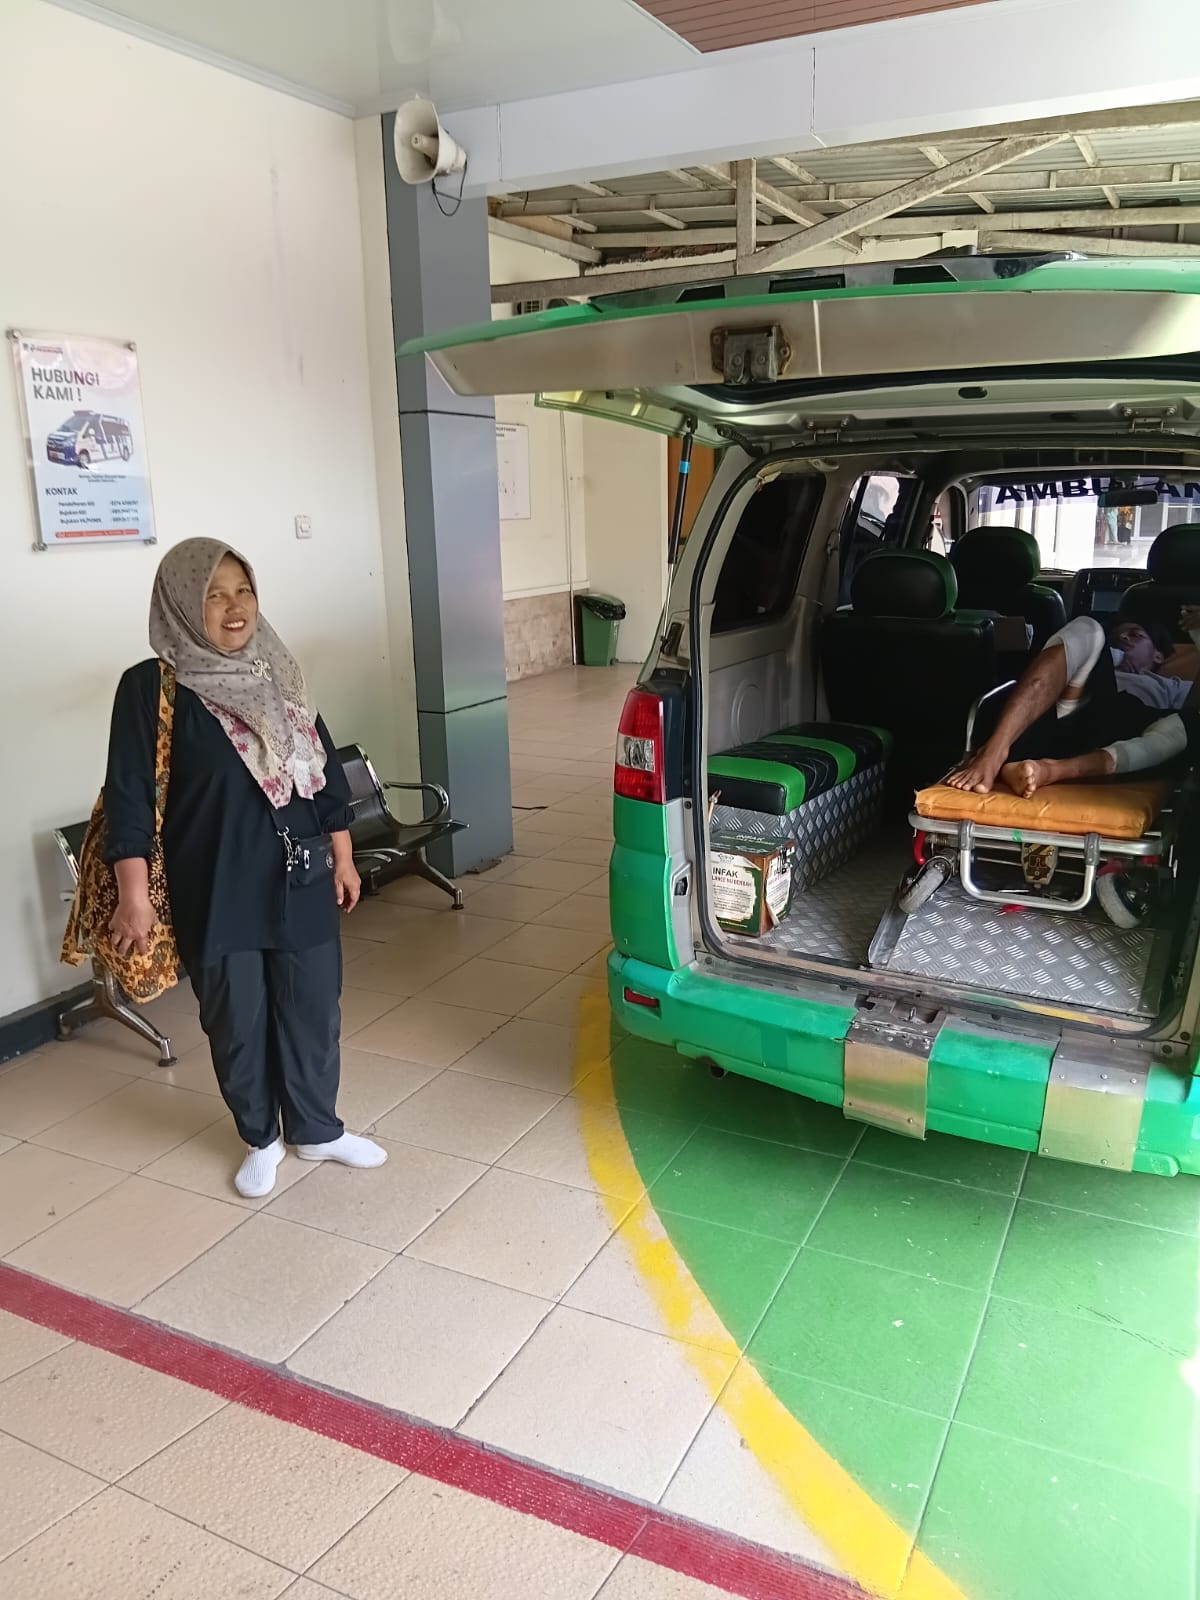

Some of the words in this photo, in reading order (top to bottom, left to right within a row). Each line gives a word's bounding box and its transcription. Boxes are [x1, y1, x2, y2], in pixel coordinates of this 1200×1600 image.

[31, 366, 100, 387] HUBUNGI
[33, 385, 74, 401] KAMI
[45, 487, 79, 497] KONTAK
[712, 866, 739, 878] INFAK
